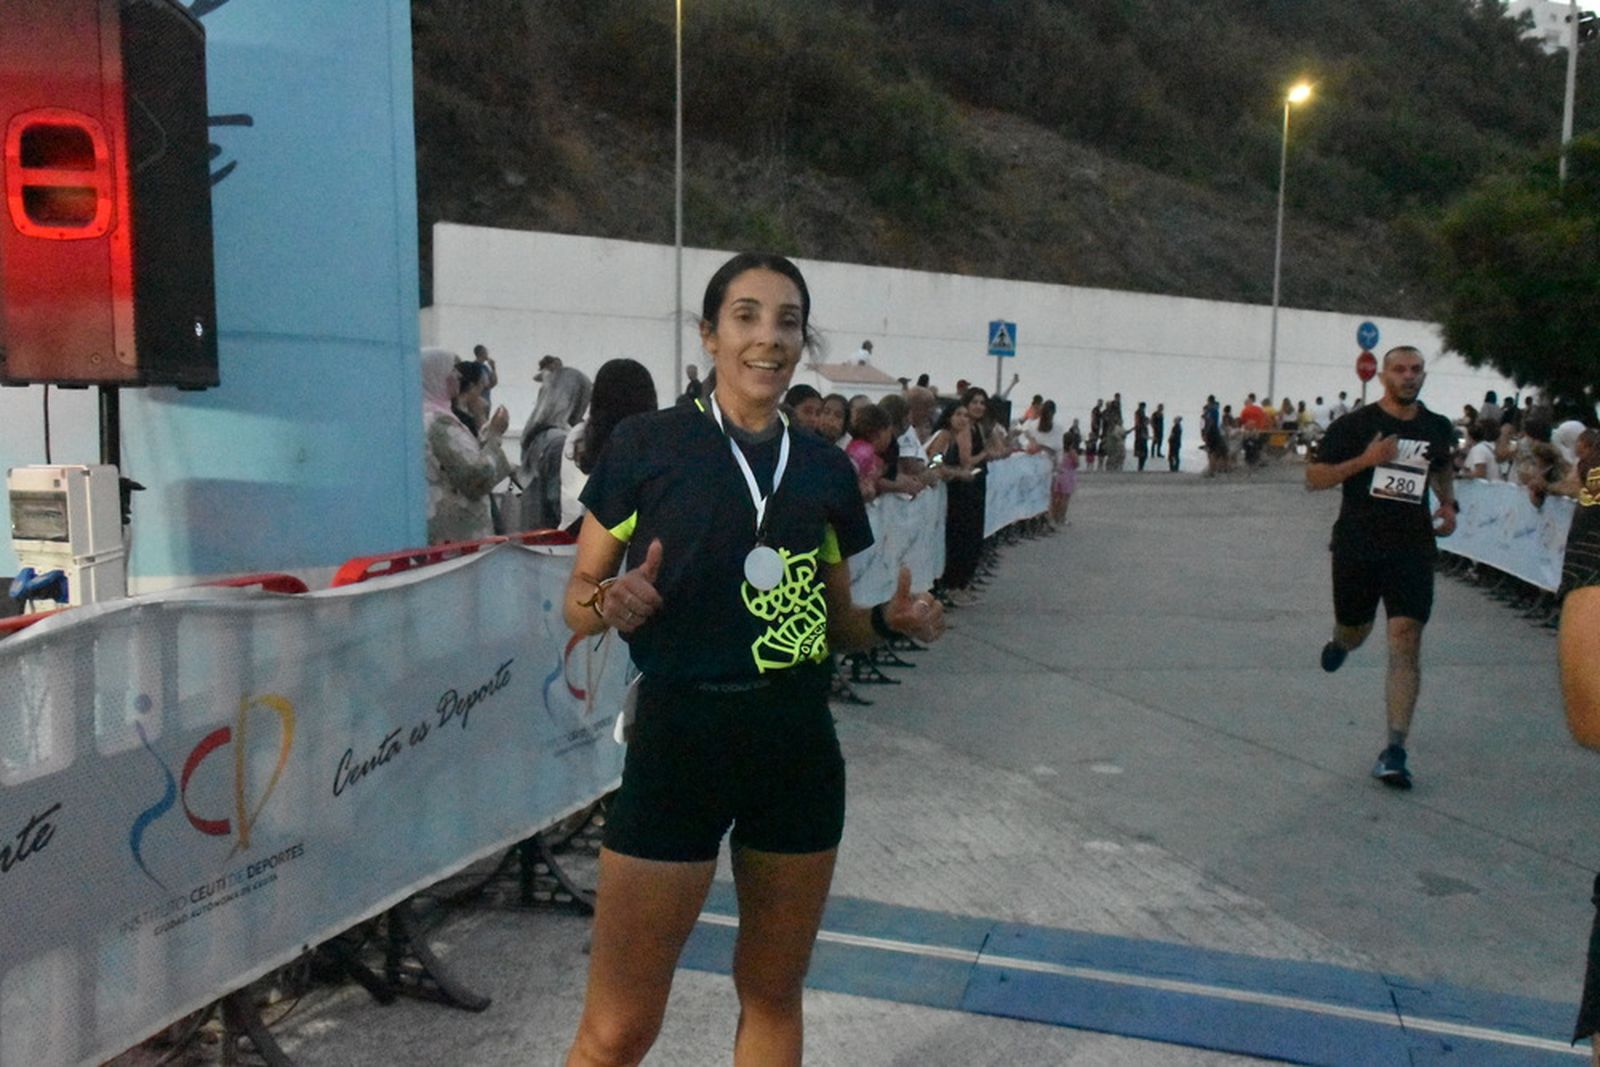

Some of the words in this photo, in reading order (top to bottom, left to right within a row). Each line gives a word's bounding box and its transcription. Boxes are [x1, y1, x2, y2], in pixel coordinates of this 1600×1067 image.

[1397, 438, 1431, 462] IKE
[1384, 475, 1416, 494] 280
[333, 728, 402, 797] Ceuta
[409, 721, 431, 746] es
[436, 658, 515, 730] Deporte
[246, 843, 304, 879] DEPORTES
